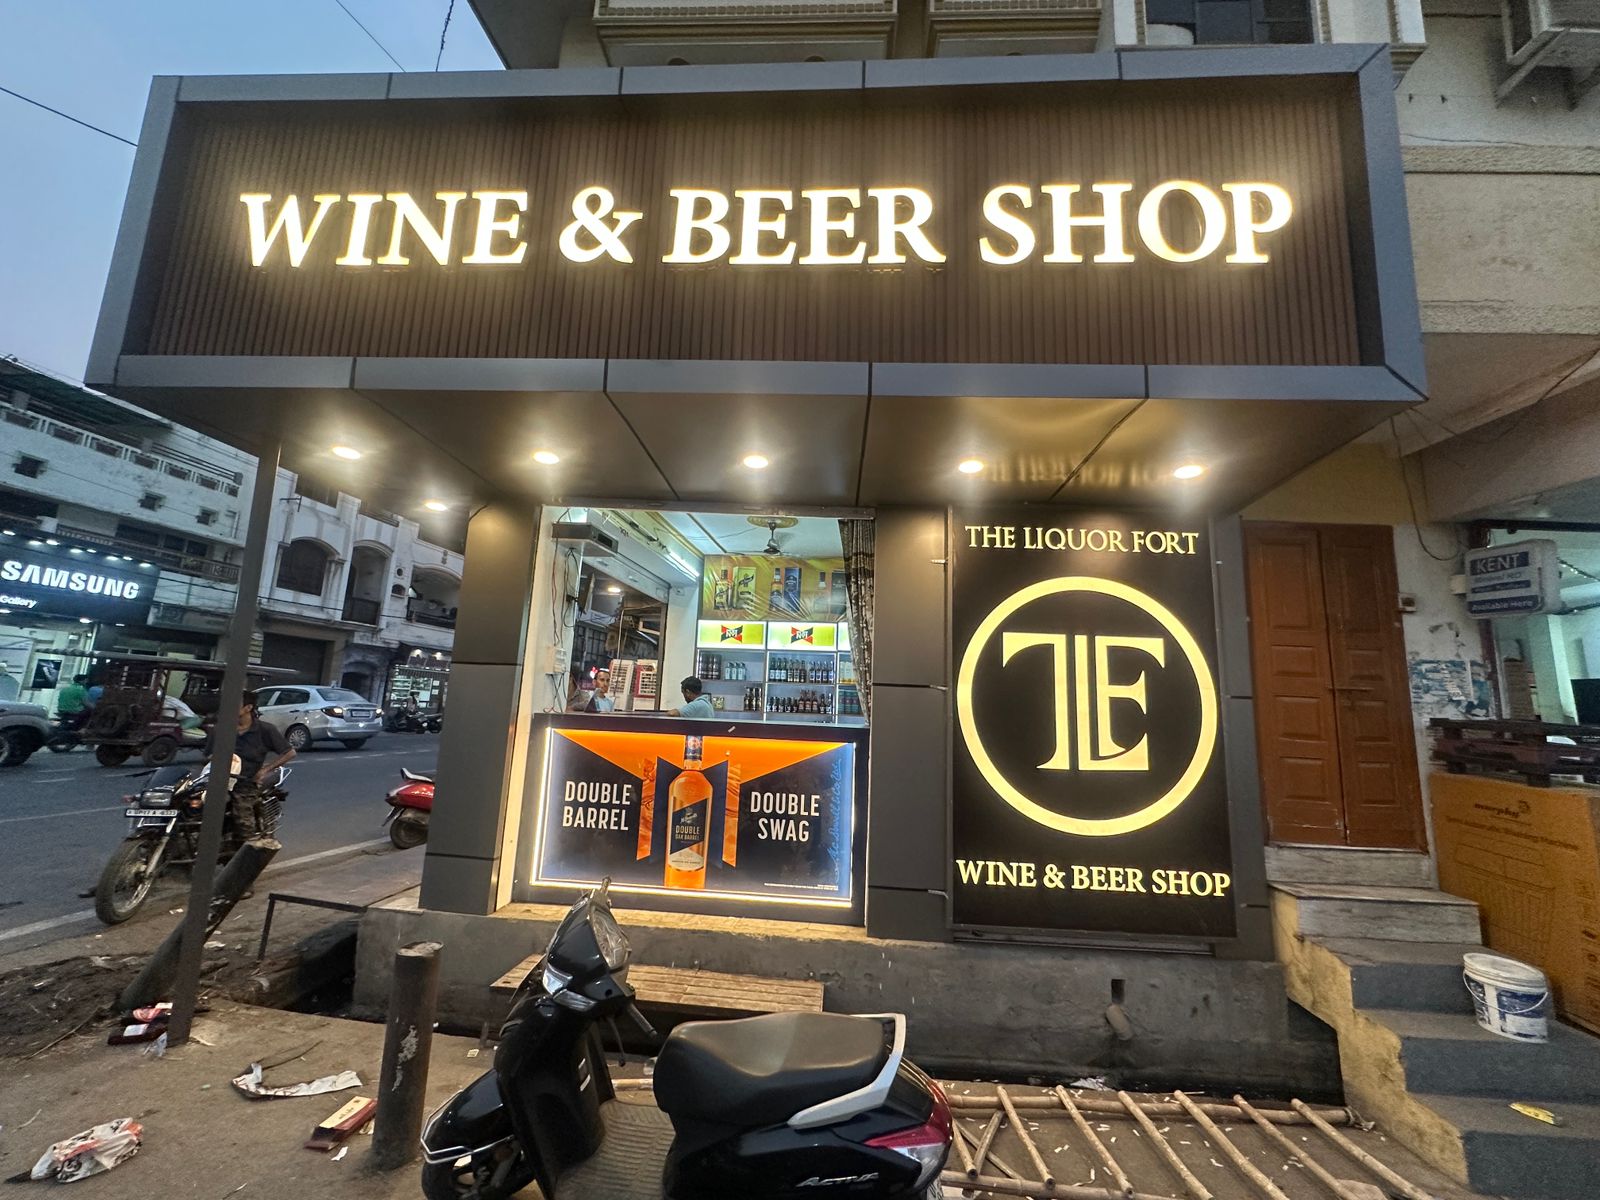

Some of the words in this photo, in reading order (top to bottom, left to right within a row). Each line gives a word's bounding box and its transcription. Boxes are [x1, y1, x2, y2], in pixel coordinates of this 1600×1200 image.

[240, 191, 528, 268] WINE
[558, 186, 643, 264] &
[661, 187, 947, 265] BEER
[979, 180, 1293, 265] SHOP
[965, 525, 1016, 549] THE
[1024, 527, 1129, 553] LIQUOR
[1132, 531, 1199, 555] FORT
[1476, 554, 1519, 573] KENT
[1, 560, 140, 600] SAMSUNG
[564, 780, 632, 806] DOUBLE
[750, 791, 820, 817] DOUBLE
[562, 805, 630, 831] BARREL
[675, 825, 700, 835] DOUBLE
[757, 818, 810, 842] SWAG
[956, 859, 1036, 887] WINE
[1043, 864, 1065, 889] &
[1071, 865, 1146, 894] BEER
[1152, 869, 1231, 897] SHOP
